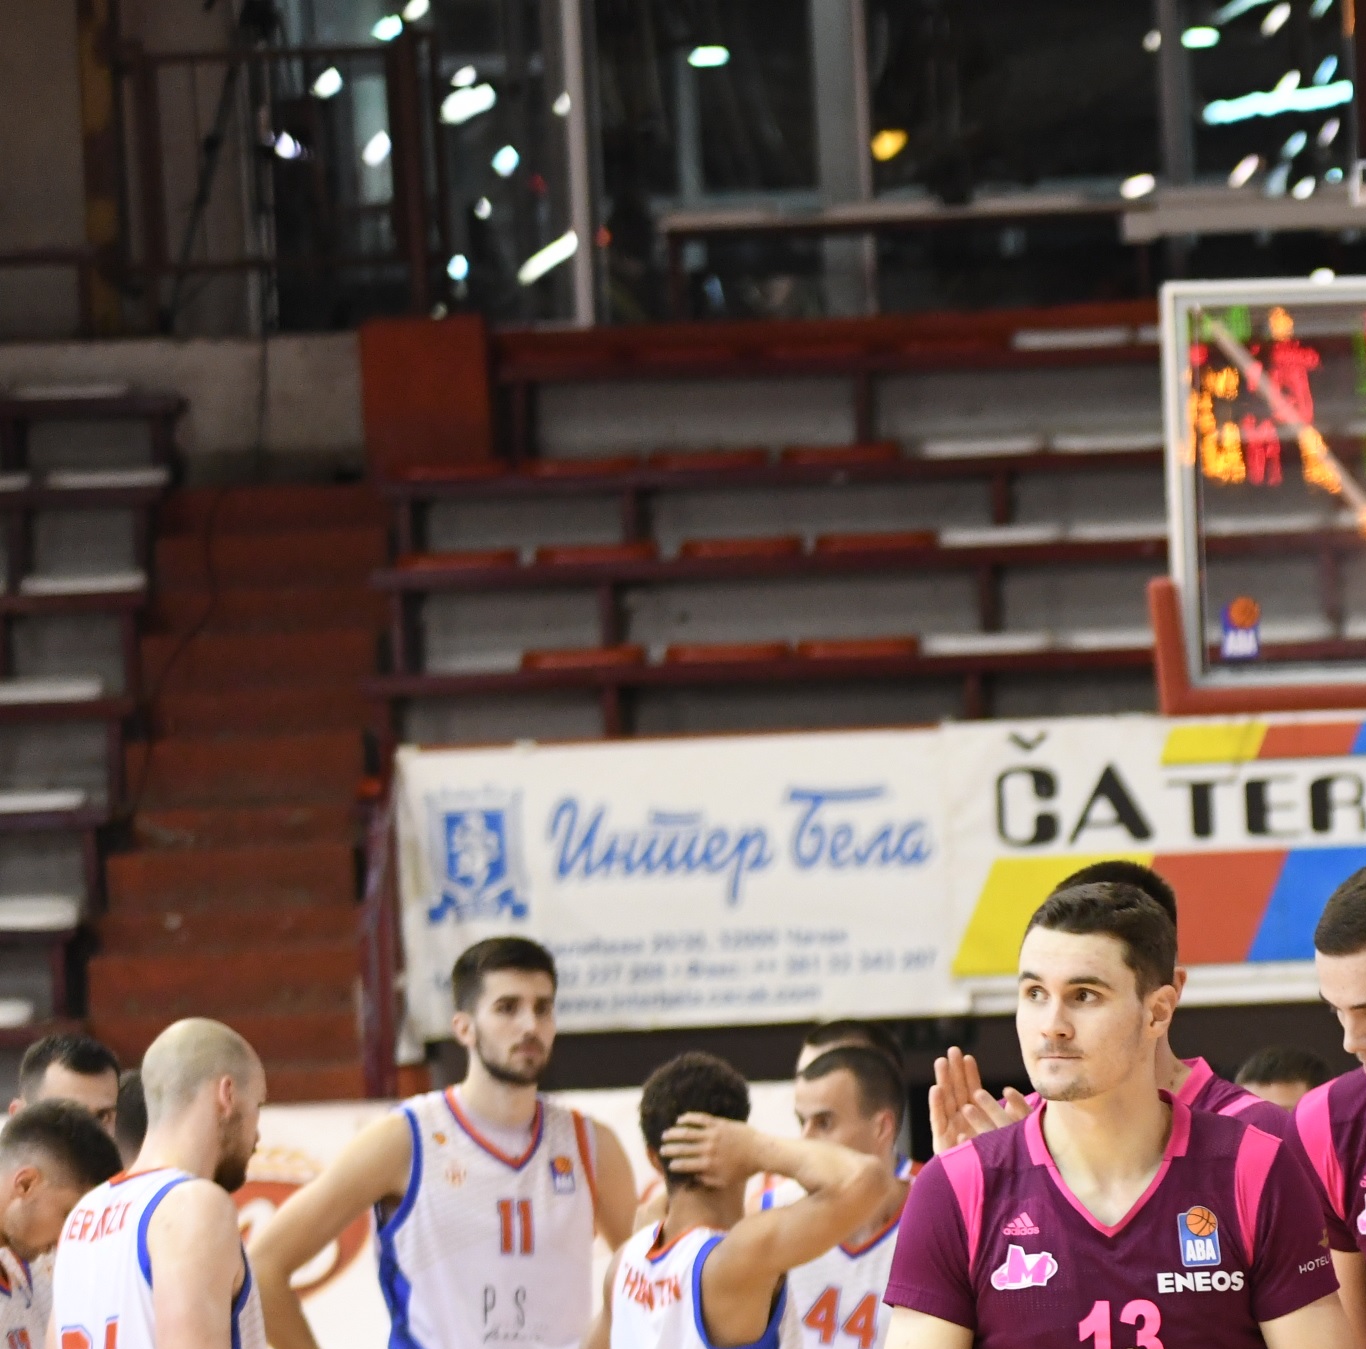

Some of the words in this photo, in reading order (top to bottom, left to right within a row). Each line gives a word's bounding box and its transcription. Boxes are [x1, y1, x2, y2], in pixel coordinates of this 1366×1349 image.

[497, 1198, 536, 1257] 11
[1002, 1226, 1041, 1236] adidas
[1184, 1239, 1218, 1262] ABA
[1156, 1269, 1245, 1294] ENEOS
